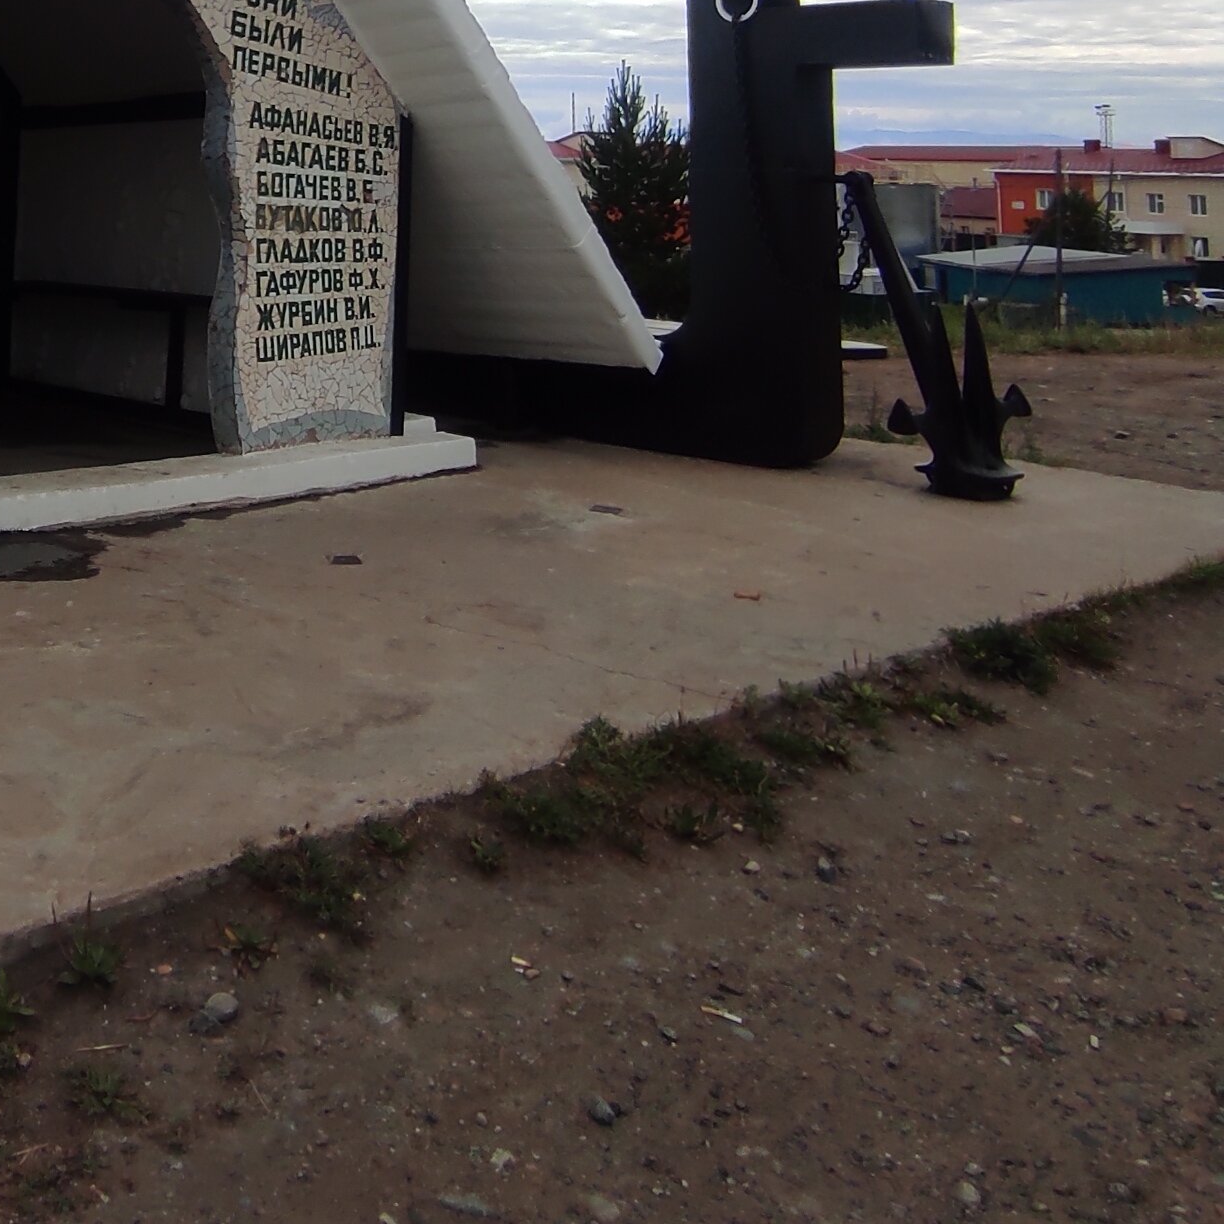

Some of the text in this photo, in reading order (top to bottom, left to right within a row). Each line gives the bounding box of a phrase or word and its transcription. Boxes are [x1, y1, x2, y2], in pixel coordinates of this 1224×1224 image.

[231, 10, 302, 54] БЫЛИ
[232, 45, 353, 98] ПЕРВЫМИ!
[249, 101, 363, 145] АФАНАСЬЕВ
[256, 137, 349, 172] АБАГАЕВ
[257, 171, 341, 201] БОГАЧЕВ
[256, 203, 343, 233] БУТАКОВ
[256, 237, 345, 263] ГЛАДКОВ
[256, 268, 343, 297] ГАФУРОВ
[256, 297, 338, 330] ЖУРБИН
[256, 328, 346, 362] ШИРАПОВ
